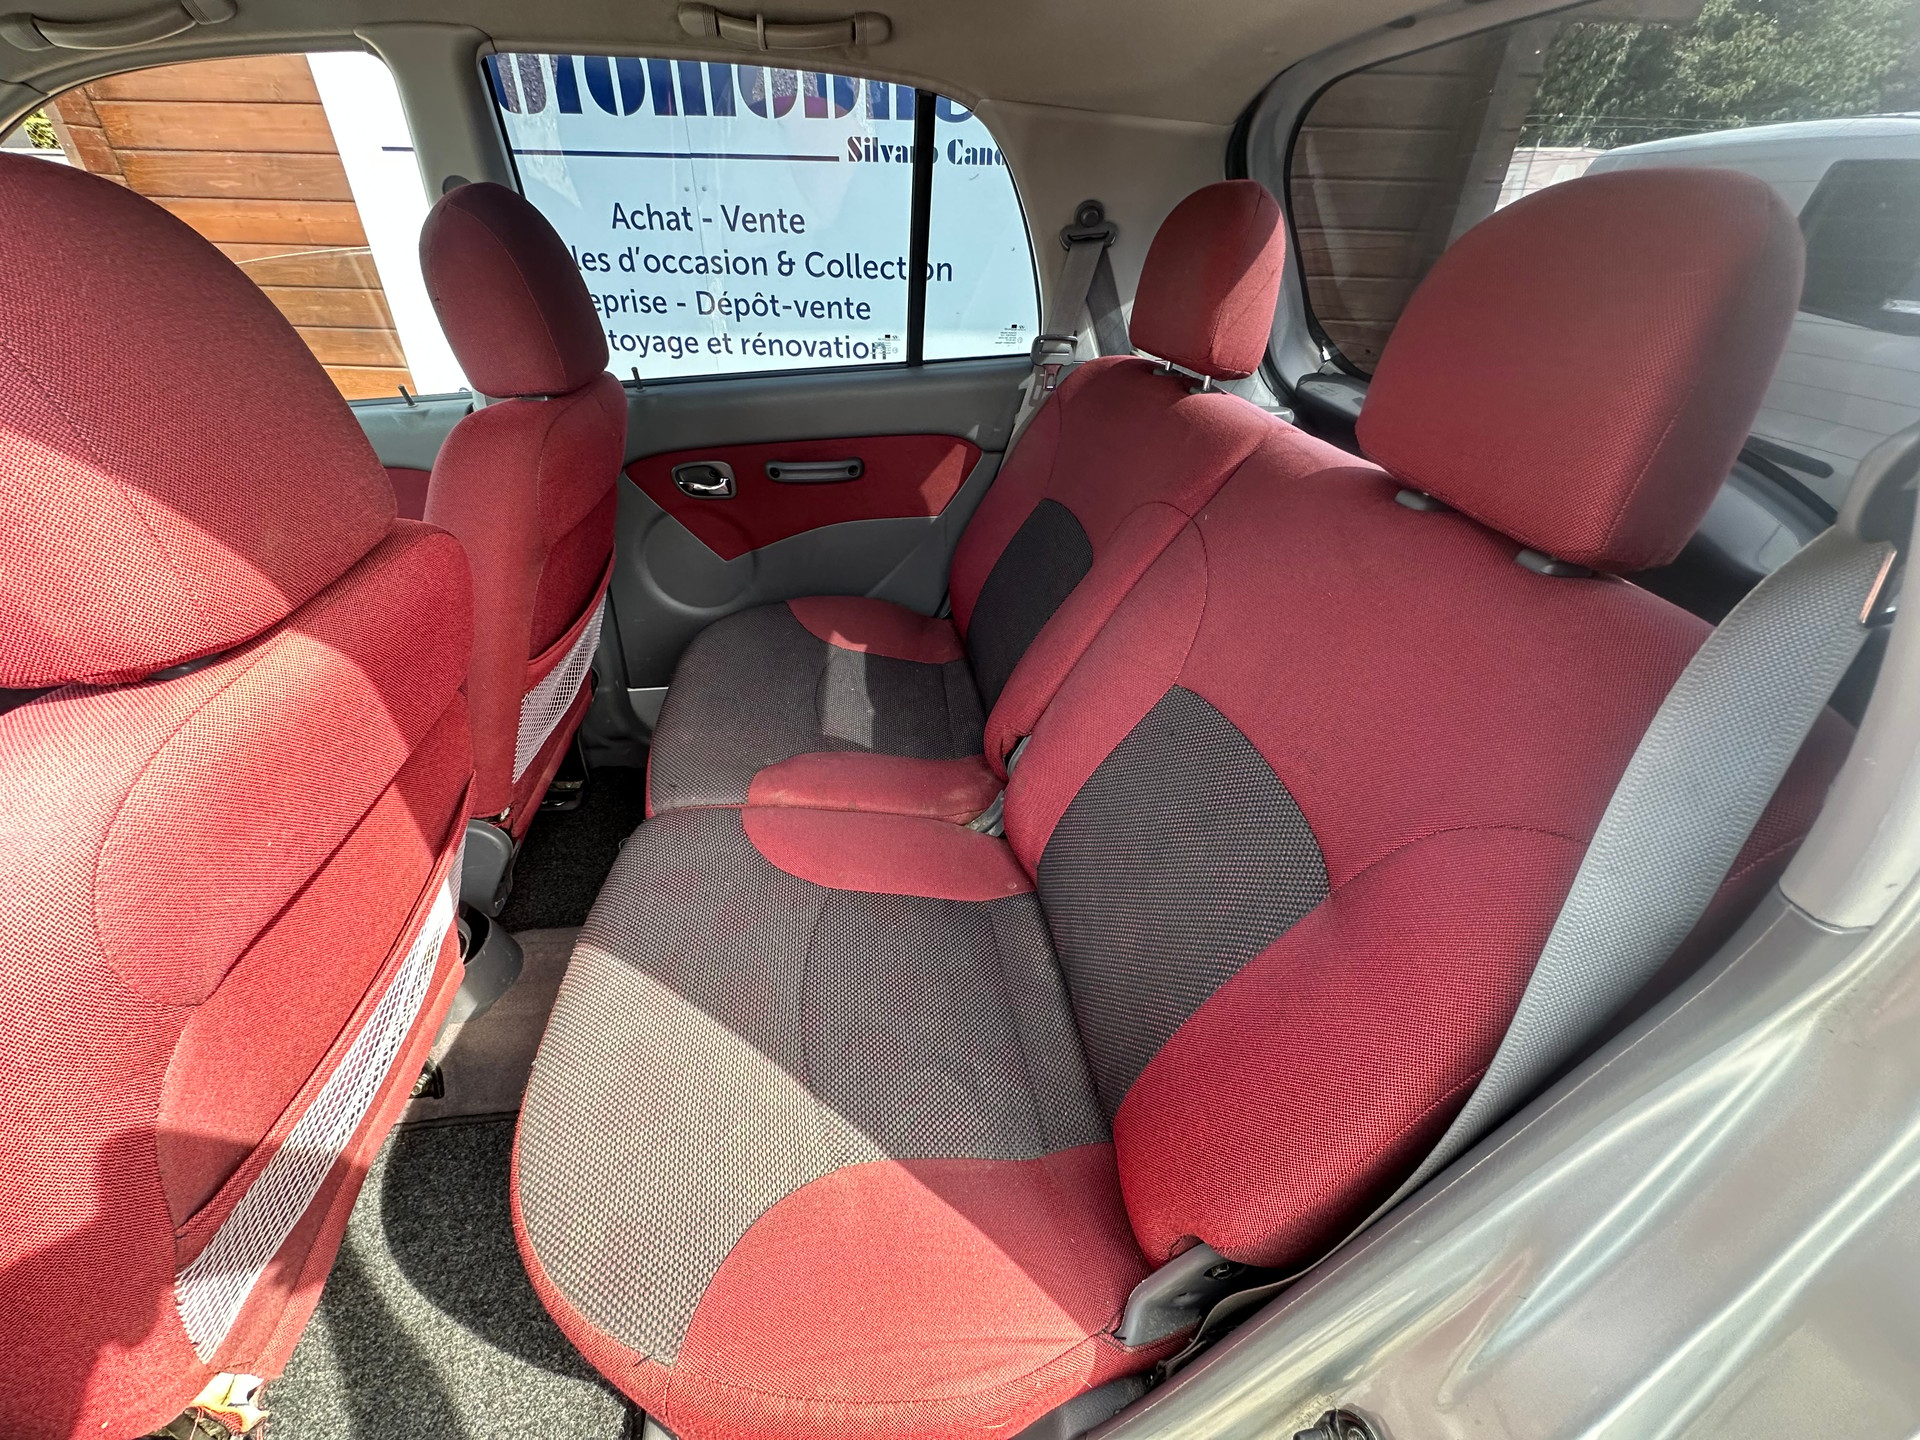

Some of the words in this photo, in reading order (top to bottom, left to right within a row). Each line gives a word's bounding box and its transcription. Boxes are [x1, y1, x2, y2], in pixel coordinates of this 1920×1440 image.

[847, 136, 939, 163] Silva
[611, 202, 694, 232] Achat
[720, 204, 806, 234] Vente
[618, 246, 768, 276] d'occasion
[777, 250, 796, 277] &
[805, 251, 953, 282] Collectn
[695, 290, 871, 323] Dépôt-vente
[607, 329, 699, 360] toyage
[707, 333, 733, 355] et
[740, 332, 887, 360] rénovation
